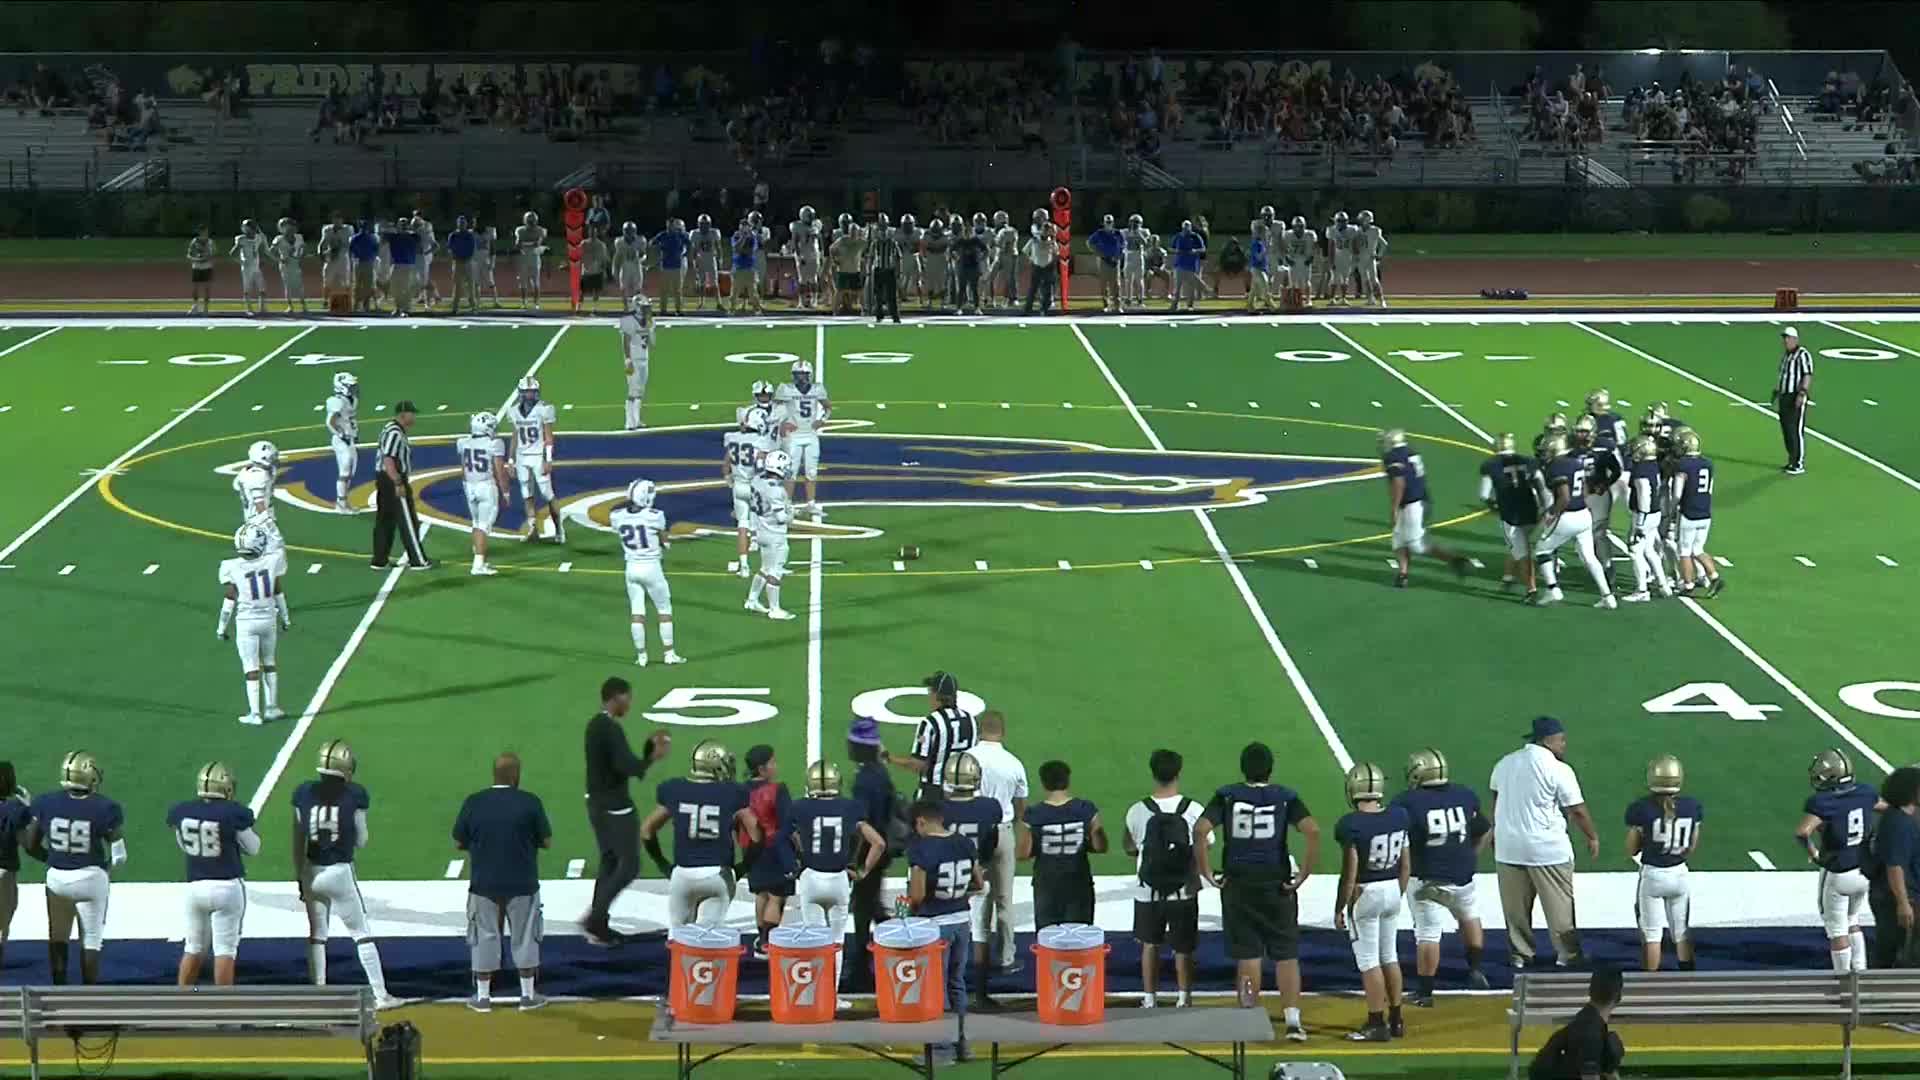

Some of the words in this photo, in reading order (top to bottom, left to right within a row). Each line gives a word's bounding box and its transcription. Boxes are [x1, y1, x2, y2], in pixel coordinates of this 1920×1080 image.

[246, 63, 375, 97] PRIDE
[379, 63, 432, 96] IN
[800, 401, 811, 418] 5
[464, 448, 489, 472] 45
[730, 442, 754, 466] 33
[619, 524, 649, 550] 21
[244, 568, 271, 600] 11
[950, 720, 968, 750] L
[51, 817, 91, 853] 59
[181, 817, 221, 857] 58
[310, 805, 340, 842] 14
[678, 803, 720, 839] 75
[811, 817, 843, 854] 17
[1232, 801, 1276, 839] 65
[1427, 807, 1467, 846] 94
[1652, 817, 1693, 855] 40
[1847, 808, 1863, 846] 9
[936, 859, 972, 899] 35
[692, 962, 713, 984] G
[792, 961, 813, 984] G
[896, 960, 917, 983] G
[1061, 967, 1082, 990] G
